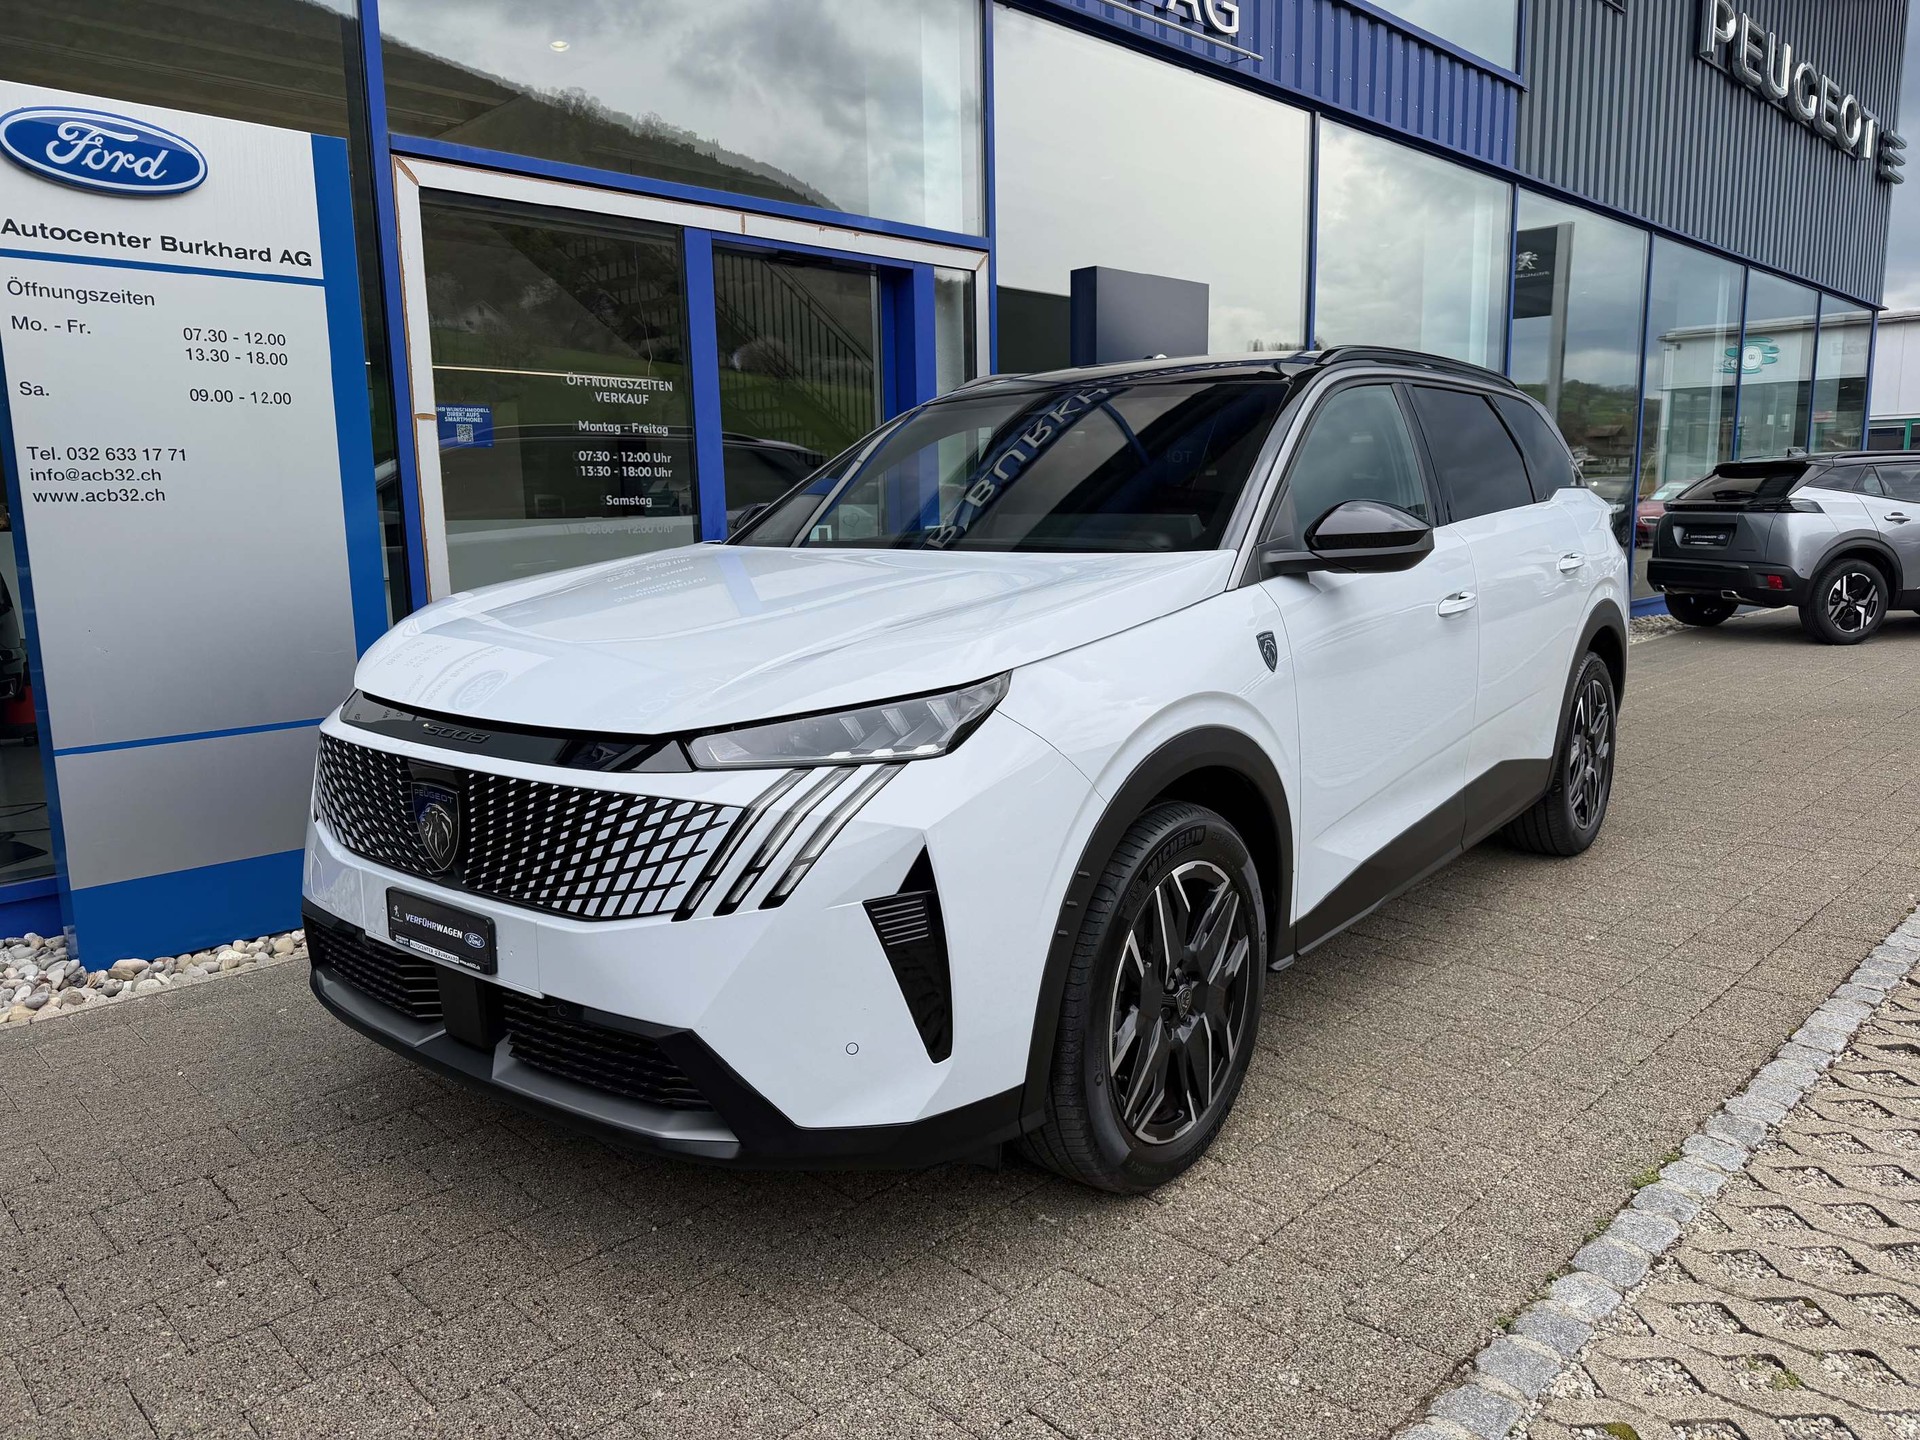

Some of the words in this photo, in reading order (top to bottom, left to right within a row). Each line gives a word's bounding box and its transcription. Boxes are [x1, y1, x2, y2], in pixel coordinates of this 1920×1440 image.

[1699, 0, 1880, 161] PEUGEOT
[45, 120, 167, 180] Ford
[0, 218, 152, 249] Autocenter
[160, 235, 272, 263] Burkhard
[279, 249, 312, 267] AG
[7, 276, 155, 306] Öffnungszeiten
[11, 316, 47, 332] Mo.
[67, 319, 92, 335] Fr.
[183, 328, 228, 344] 07.30
[244, 332, 287, 347] 12.00
[186, 348, 229, 363] 13.30
[247, 352, 289, 367] 18.00
[20, 381, 50, 397] Sa.
[566, 371, 673, 392] ÖFFNUNGSZEITEN
[189, 388, 234, 404] 09.00
[250, 391, 292, 406] 12.00
[594, 390, 649, 405] VERKAUF
[579, 420, 621, 435] Montag
[632, 423, 669, 437] Freitag
[26, 446, 62, 461] Tel.
[67, 447, 100, 461] 032
[105, 447, 137, 462] 633
[142, 448, 162, 462] 17
[168, 448, 187, 462] 71
[578, 451, 611, 462] 07:30
[621, 452, 651, 463] 12:00
[653, 453, 672, 463] Uhr
[30, 467, 162, 482] info@acb32.ch
[580, 465, 612, 477] 13:30
[622, 467, 652, 478] 18:00
[653, 467, 673, 478] Uhr
[33, 488, 166, 503] www.acb32.ch
[605, 494, 653, 508] Samstag
[422, 723, 492, 744] 5008
[414, 788, 454, 804] PEUGEOT
[1145, 827, 1207, 884] MICHELIN
[405, 912, 464, 939] VERFÜHRWAGEN
